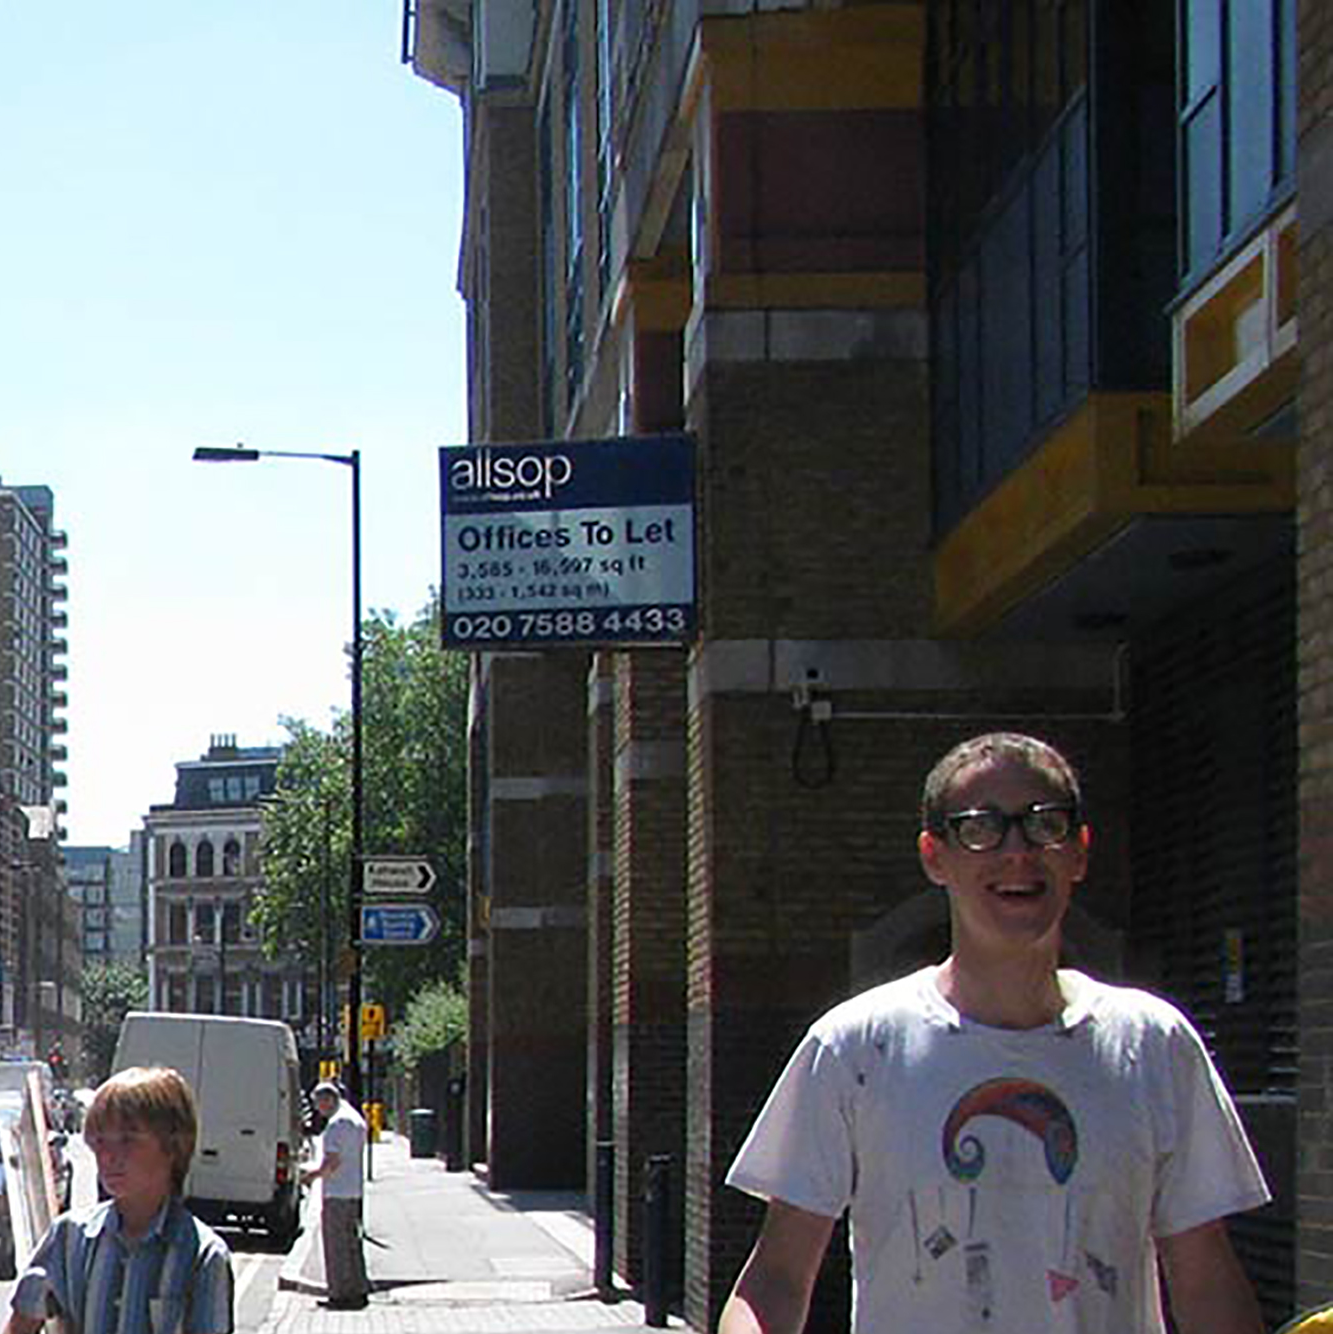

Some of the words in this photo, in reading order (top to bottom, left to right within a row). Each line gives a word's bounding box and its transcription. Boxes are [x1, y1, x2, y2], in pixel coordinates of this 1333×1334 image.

[451, 449, 571, 498] allsop
[458, 526, 570, 551] Offices
[581, 520, 613, 545] To
[626, 517, 675, 544] Let
[600, 561, 624, 576] sq
[629, 554, 645, 571] ft
[453, 616, 511, 638] 020
[520, 612, 595, 637] 7588
[603, 608, 684, 633] 4433
